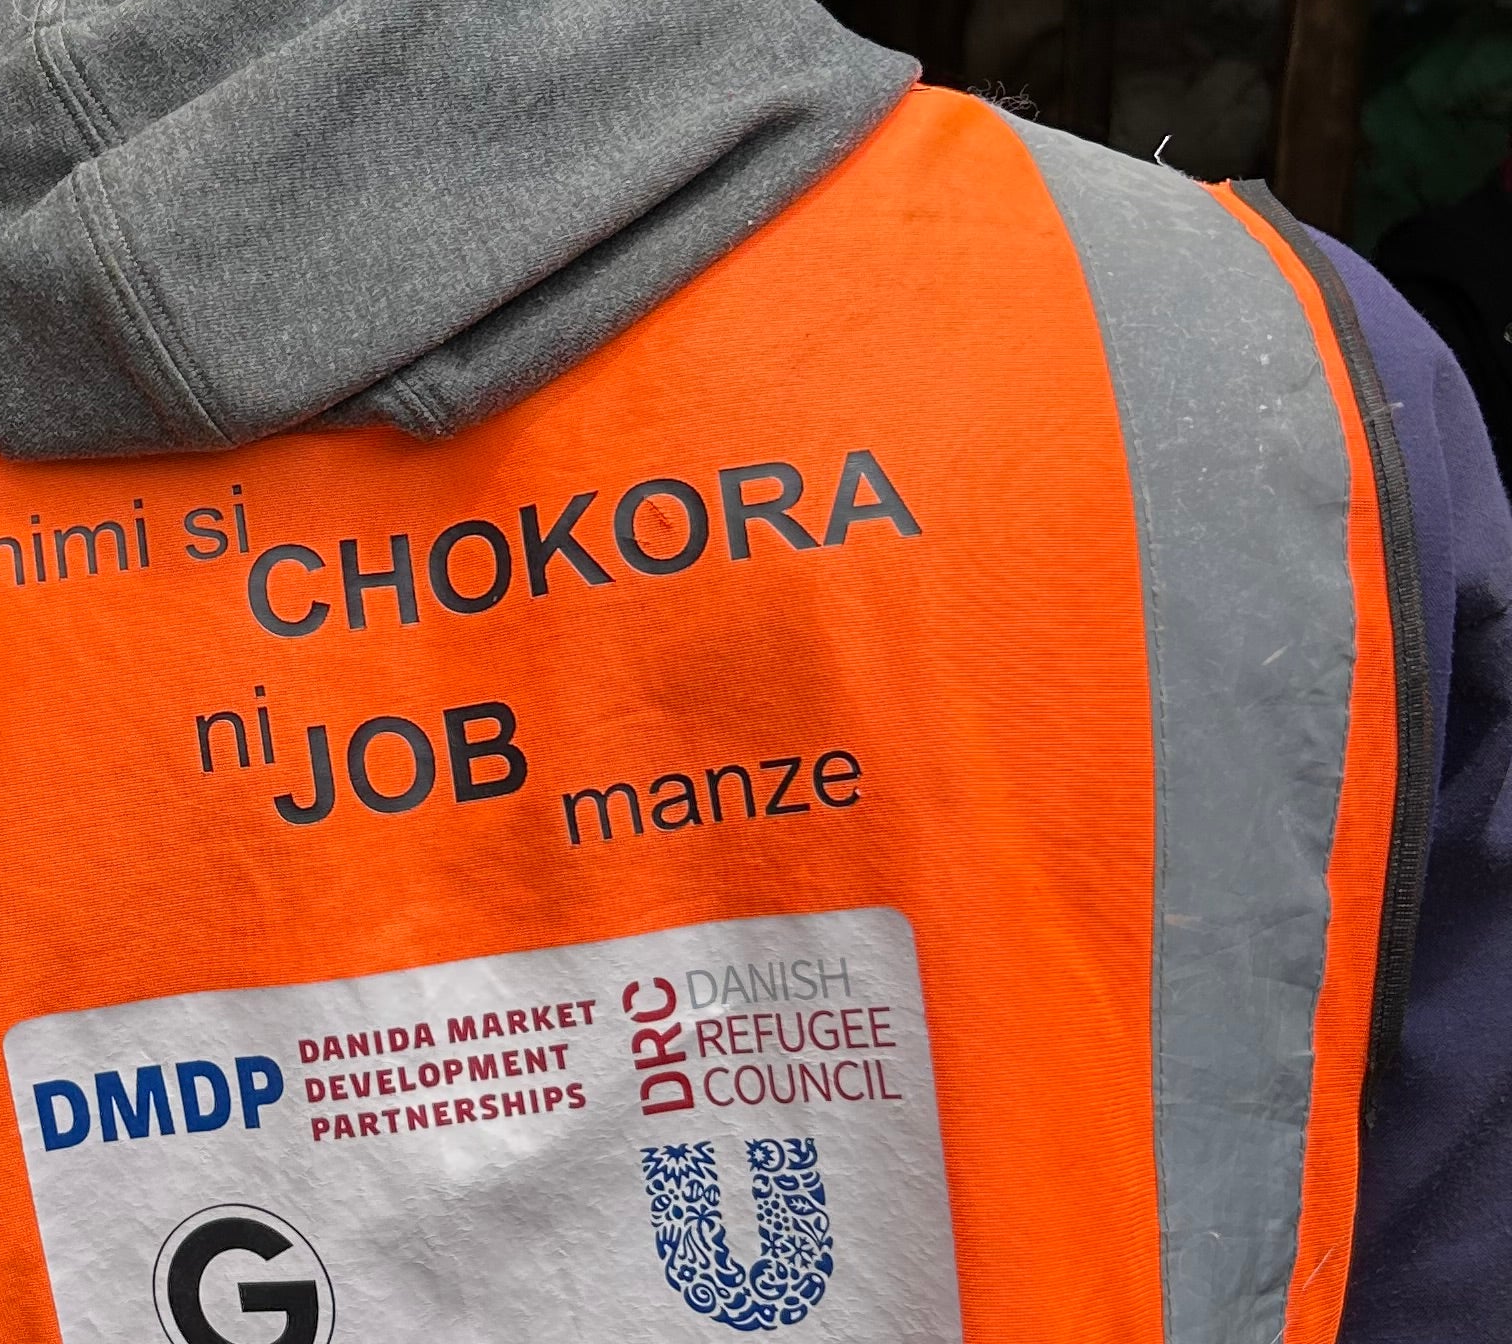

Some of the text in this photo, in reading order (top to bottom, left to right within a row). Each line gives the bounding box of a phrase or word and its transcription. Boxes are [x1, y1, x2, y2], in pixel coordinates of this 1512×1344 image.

[182, 484, 252, 564] si
[246, 449, 923, 639] CHOKORA
[194, 684, 864, 847] ni JOB manze
[685, 957, 852, 1010] DANISH
[298, 999, 598, 1064] DANIDA MARKET
[621, 976, 696, 1116] DRC
[694, 1006, 897, 1057] REFUGEE
[33, 1055, 285, 1153] DMDP
[304, 1043, 571, 1104] DEVELOPMENT
[703, 1059, 903, 1107] COUNCIL
[310, 1082, 589, 1142] PARTNERSHIPS
